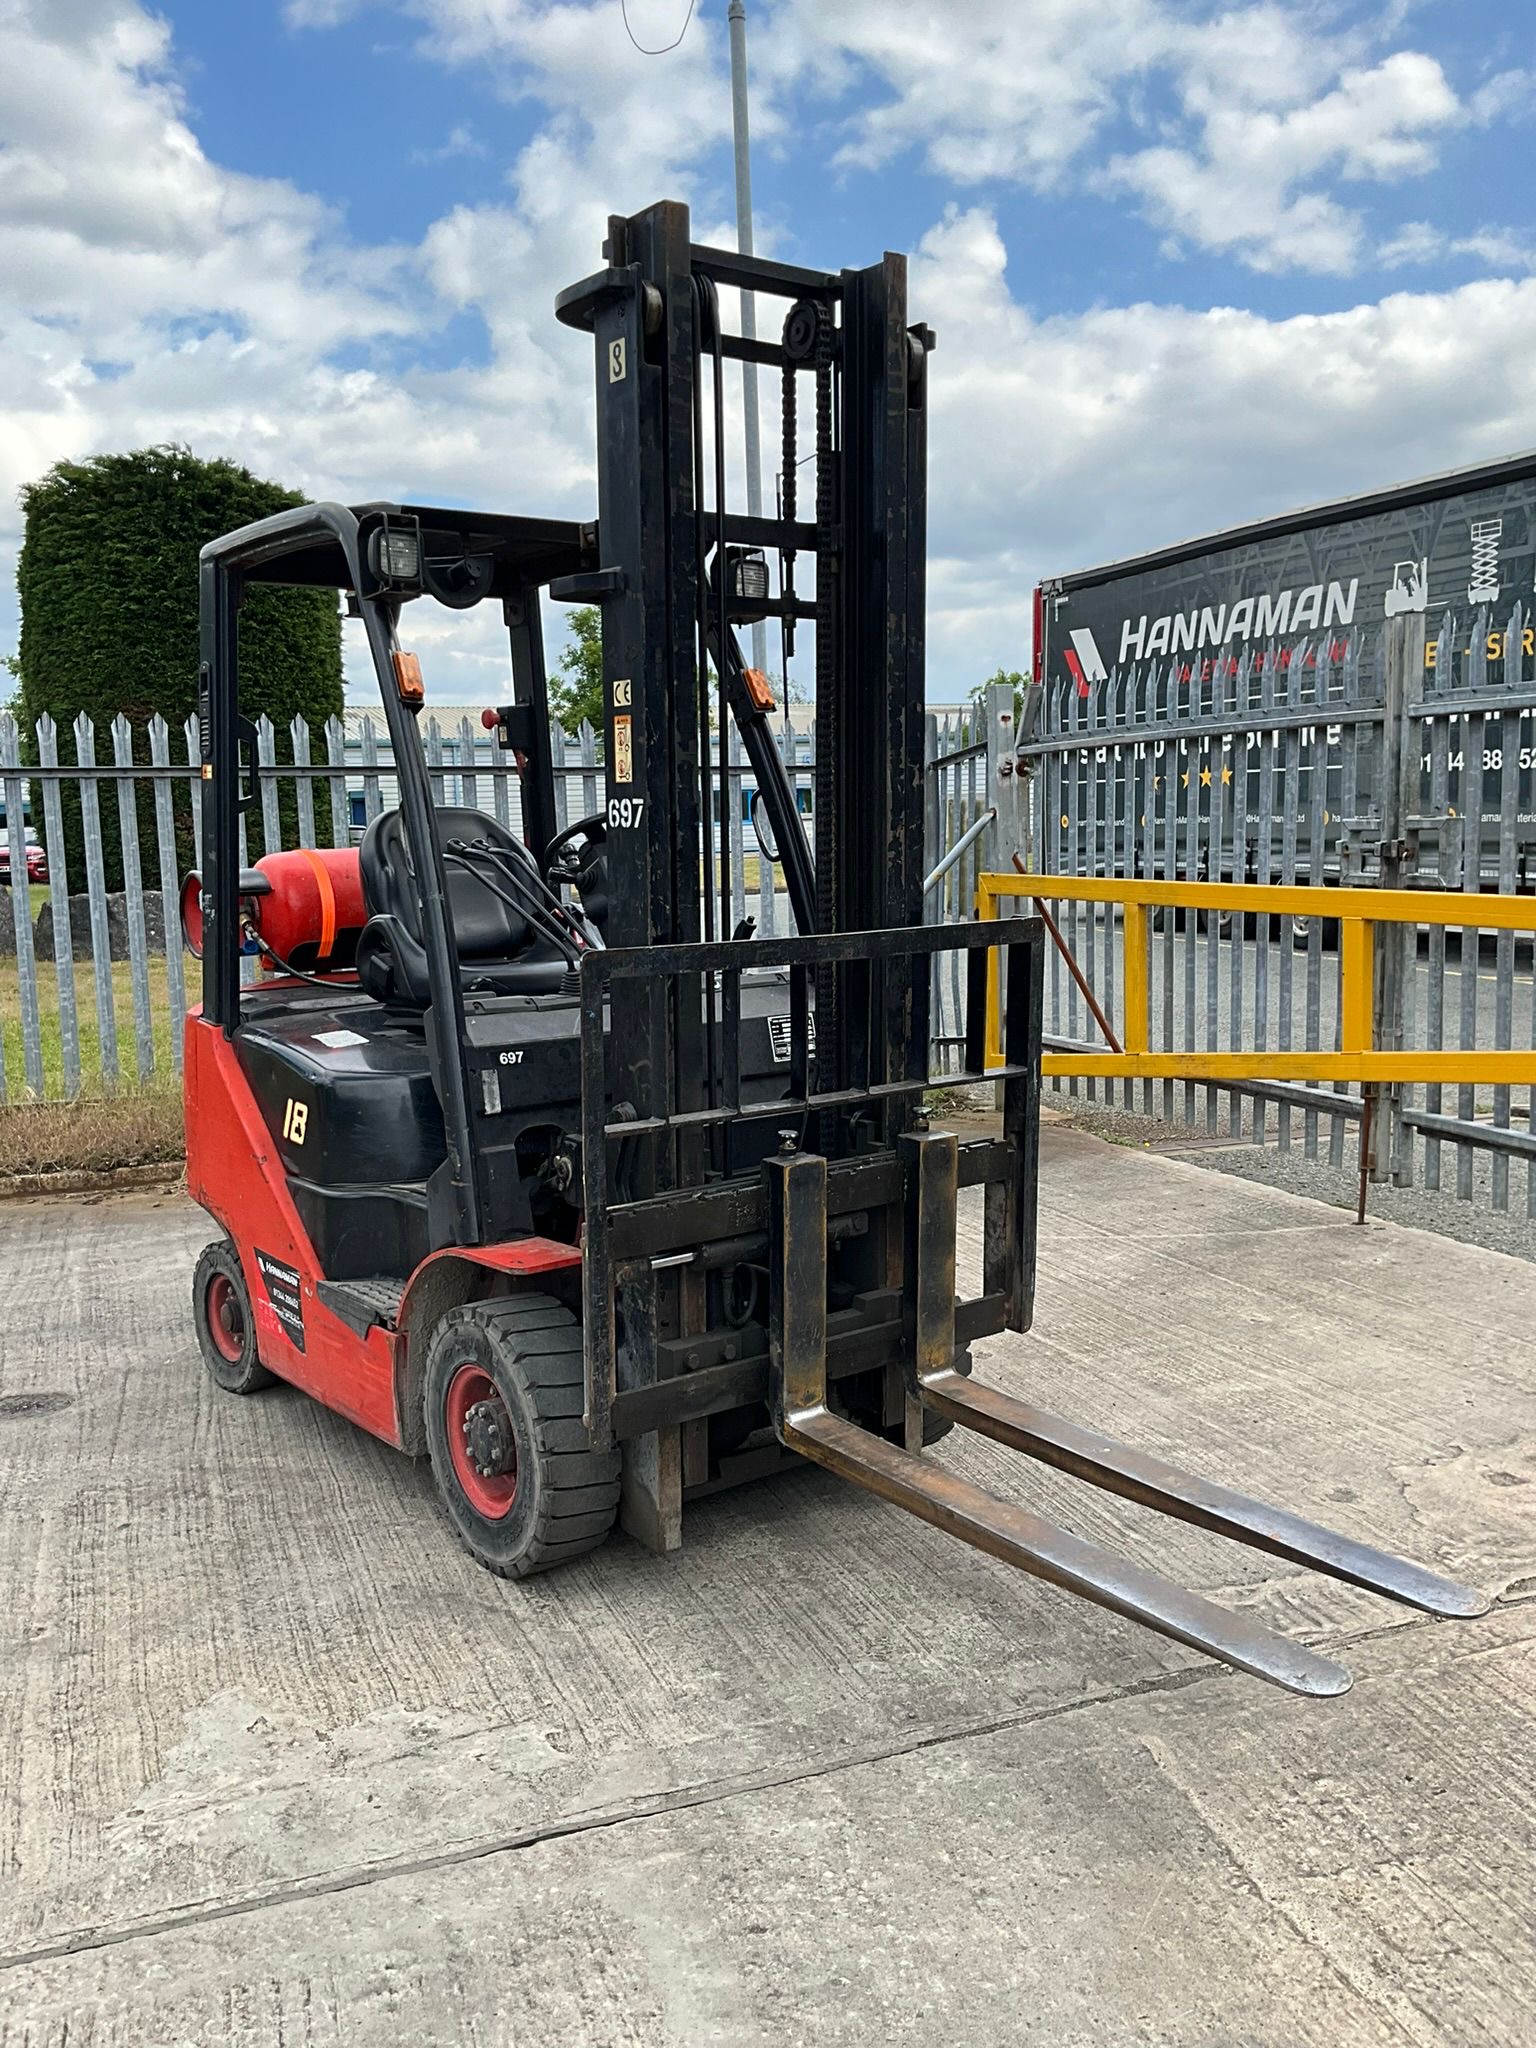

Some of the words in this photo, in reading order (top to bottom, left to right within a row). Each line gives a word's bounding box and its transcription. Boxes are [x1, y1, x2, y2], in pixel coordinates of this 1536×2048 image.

[1118, 578, 1359, 664] HANNAMAN
[609, 798, 644, 829] 697
[499, 1051, 524, 1065] 697
[283, 1097, 309, 1145] 18
